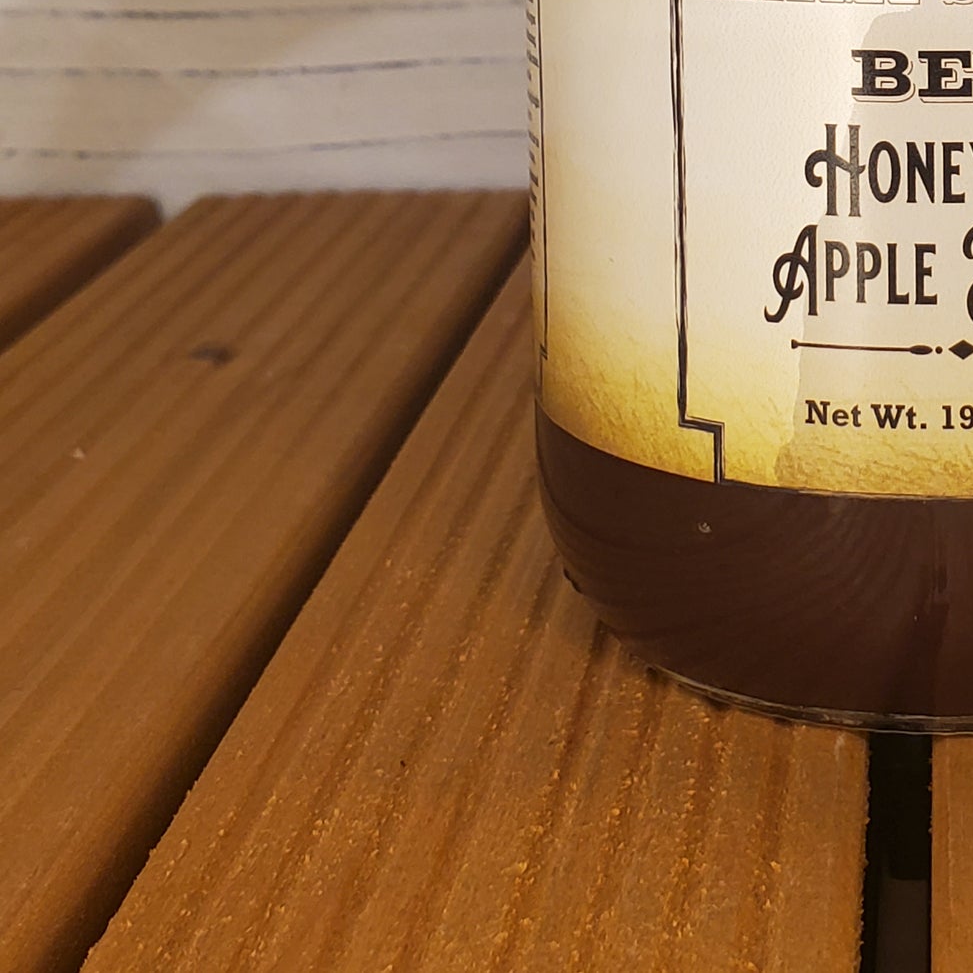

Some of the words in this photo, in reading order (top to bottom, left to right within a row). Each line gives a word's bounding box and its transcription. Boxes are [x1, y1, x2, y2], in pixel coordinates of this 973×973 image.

[764, 224, 938, 323] APPLE
[804, 399, 862, 427] Net
[870, 403, 928, 429] Wt.
